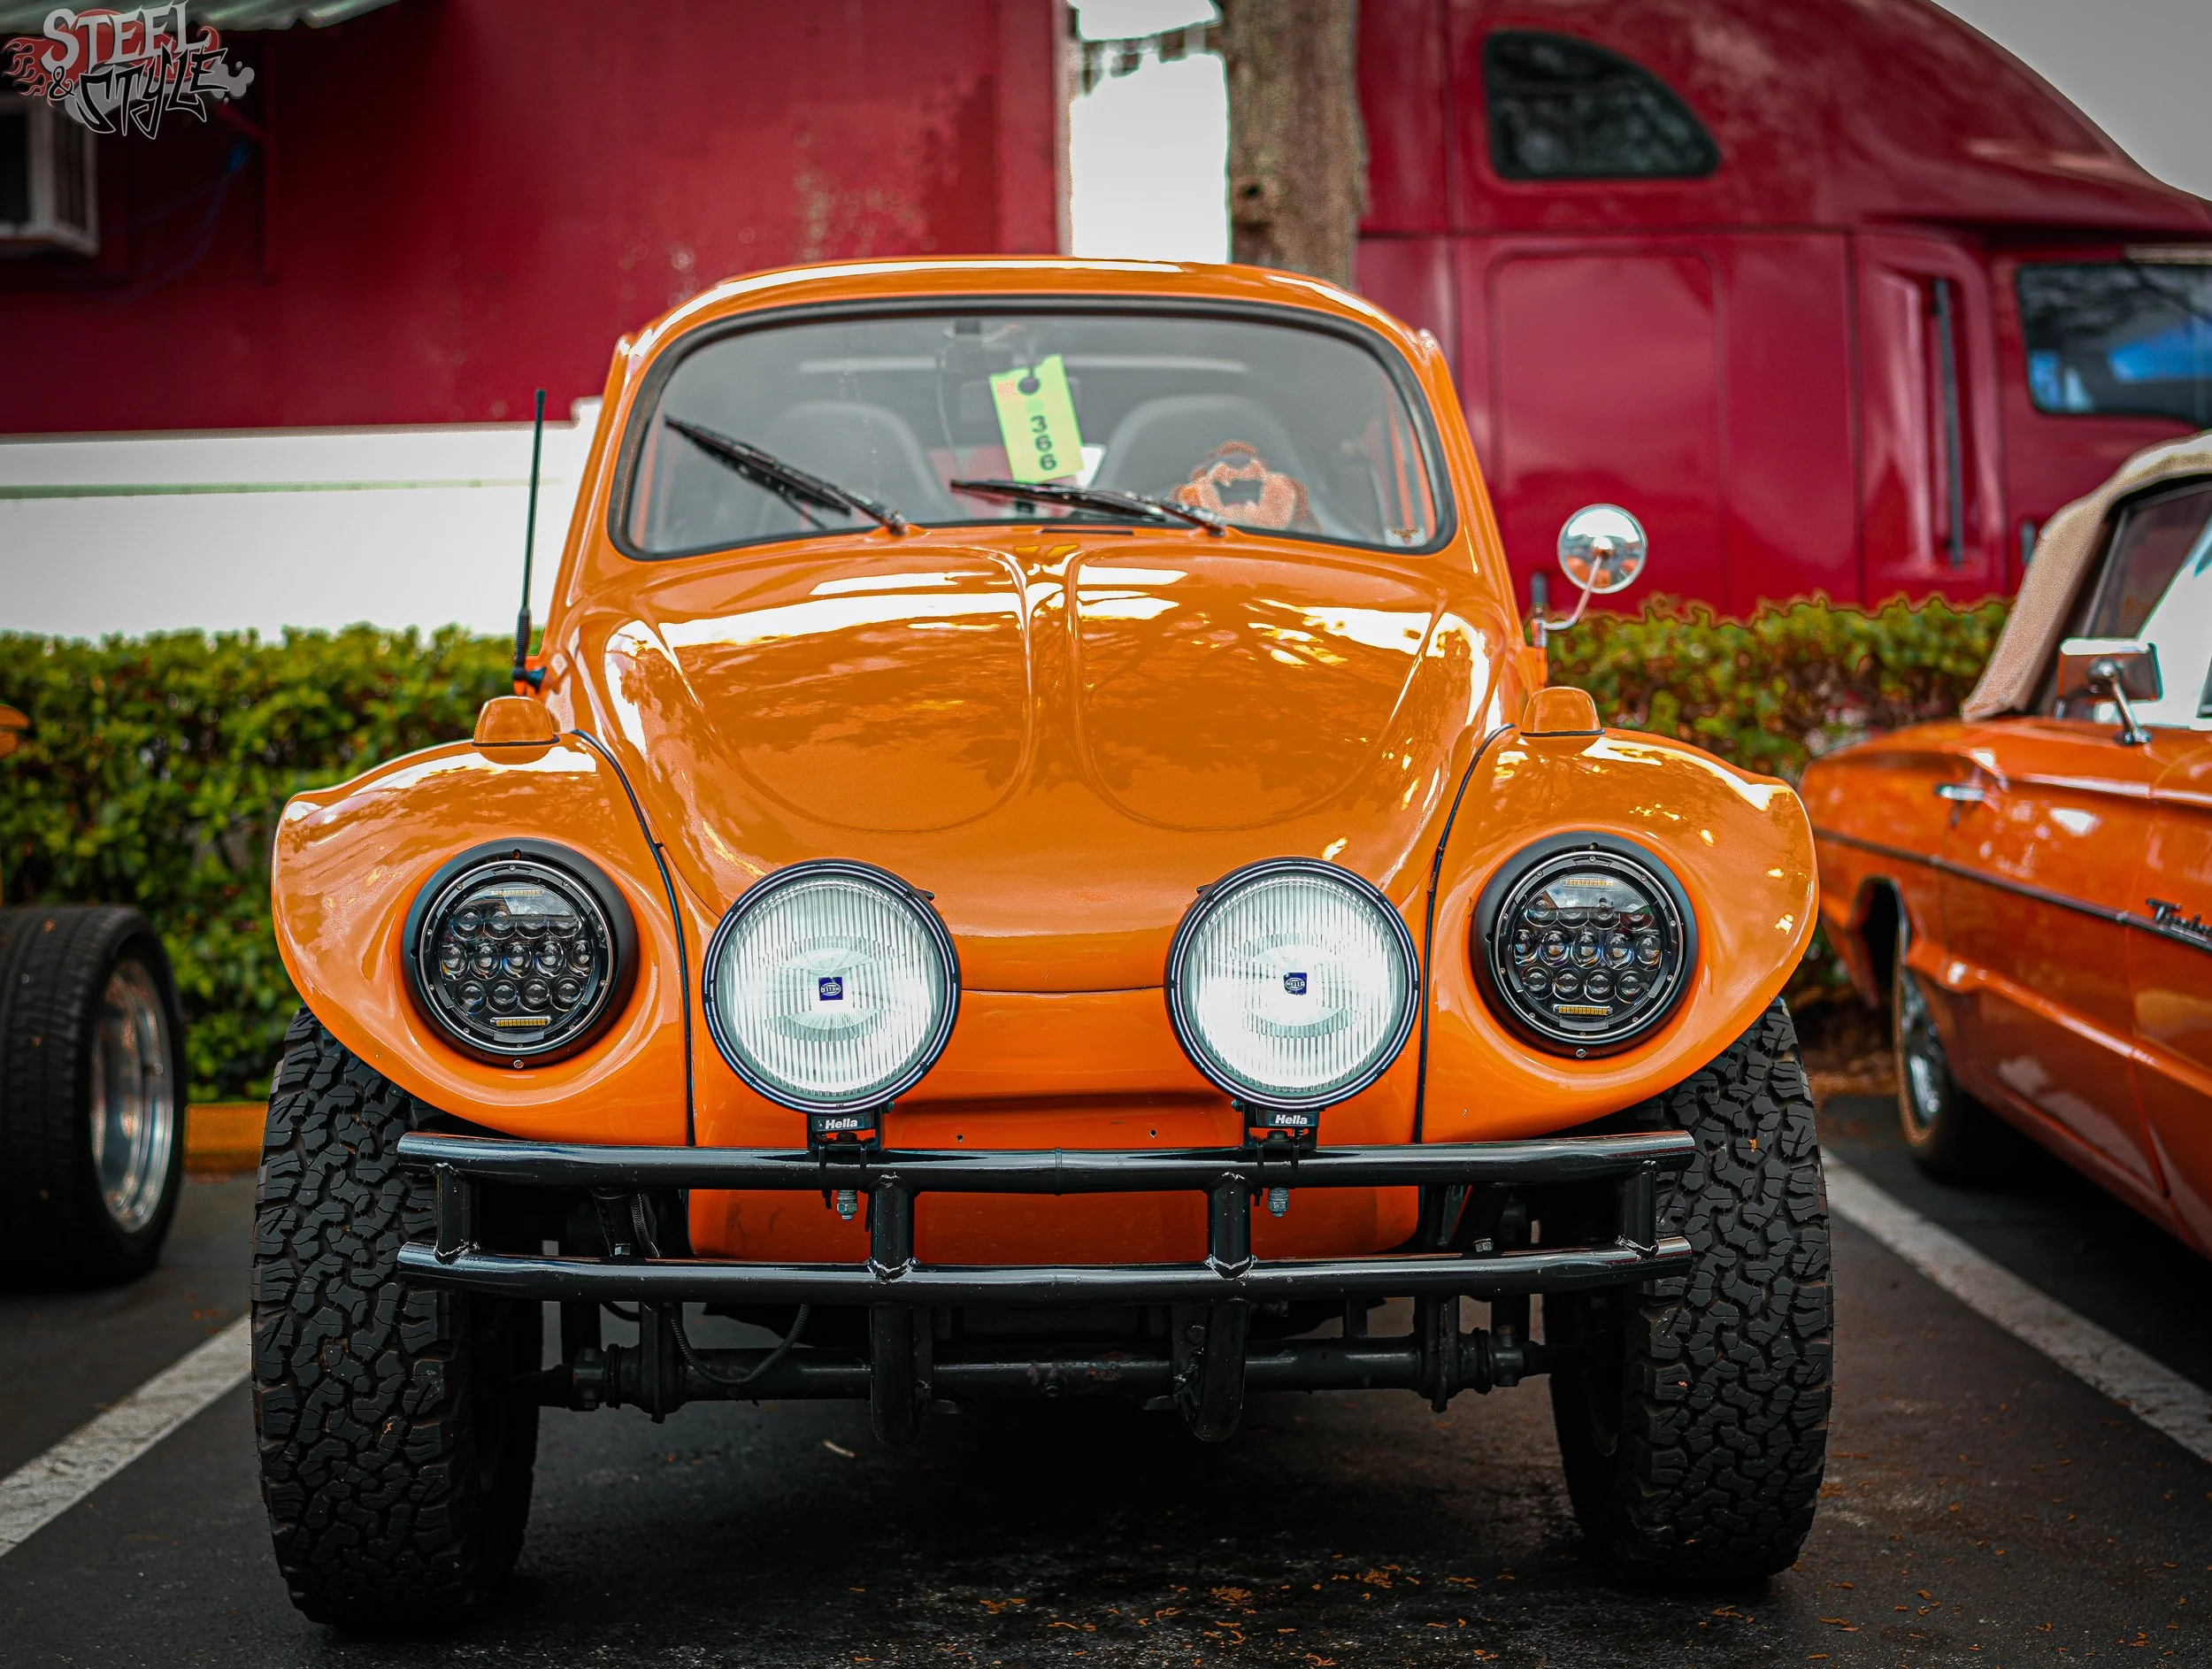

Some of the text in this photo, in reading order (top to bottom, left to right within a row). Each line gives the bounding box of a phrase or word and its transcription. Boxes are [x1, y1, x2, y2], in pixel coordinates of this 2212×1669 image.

[1029, 414, 1058, 471] 366
[825, 1118, 858, 1129] Hella
[1275, 1114, 1308, 1125] Hella
